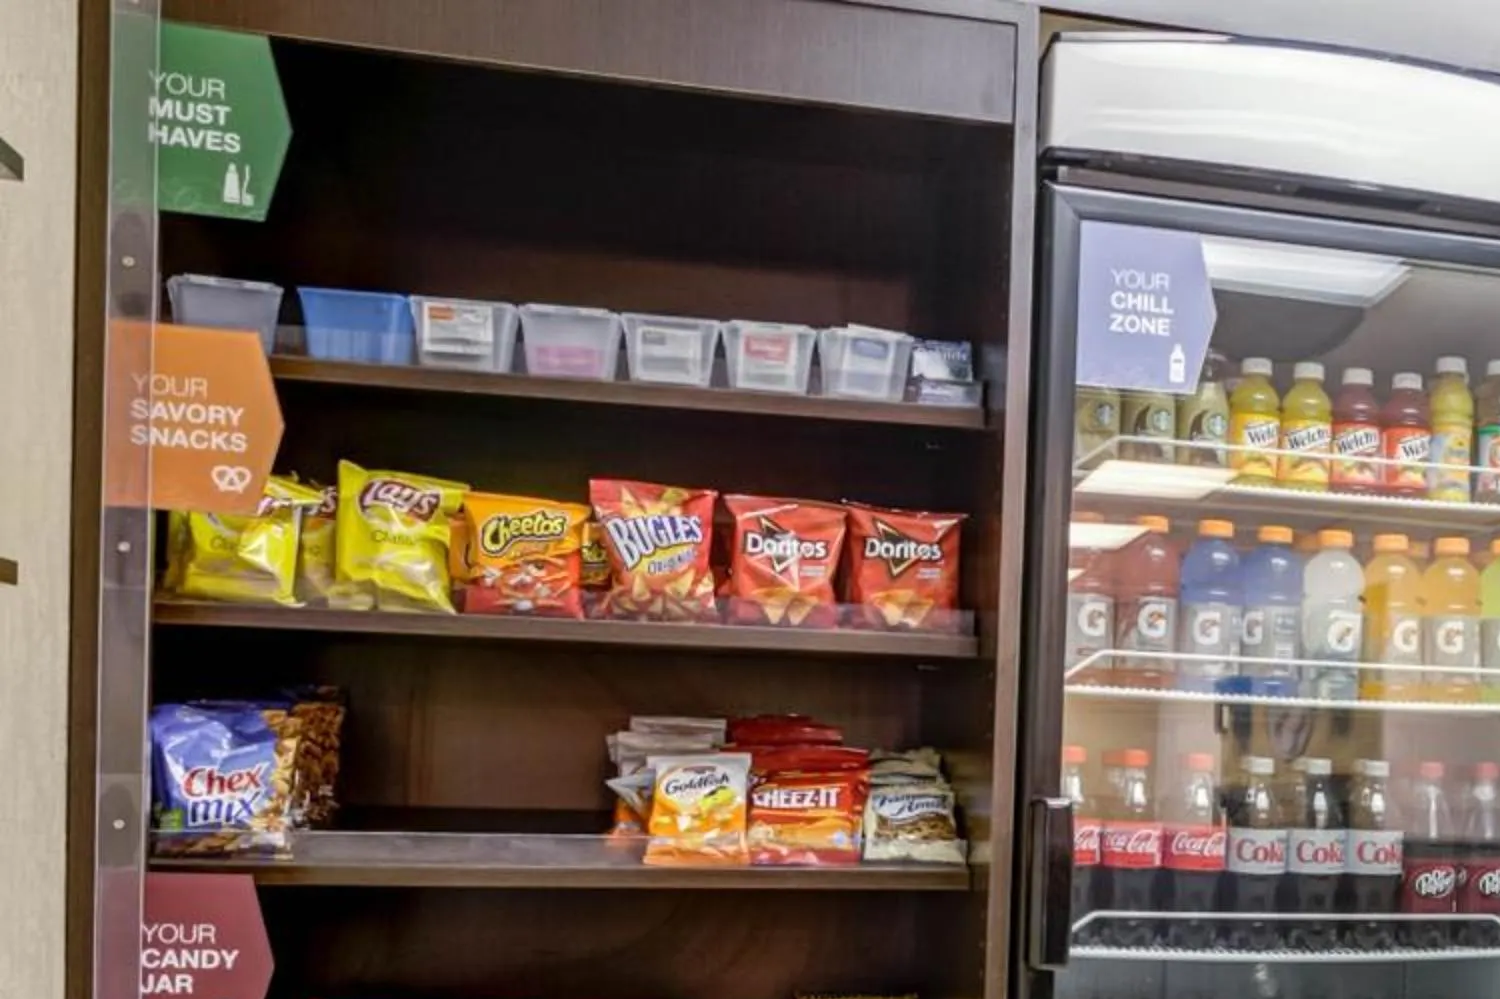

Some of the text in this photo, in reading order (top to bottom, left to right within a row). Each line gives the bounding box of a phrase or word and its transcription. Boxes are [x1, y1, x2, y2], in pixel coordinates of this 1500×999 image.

[148, 70, 225, 100] YOUR
[148, 97, 231, 126] MUST
[148, 125, 241, 153] HAVES
[1110, 269, 1170, 291] YOUR
[1110, 291, 1173, 314] CHILL
[1109, 315, 1170, 336] ZONE
[131, 373, 208, 399] YOUR
[130, 399, 243, 426] SAVORY
[130, 424, 248, 453] SNACKS
[483, 512, 566, 553] Cheetos
[604, 515, 702, 571] BUGLES
[745, 532, 827, 558] Doritos
[865, 535, 942, 561] Doritos
[184, 764, 264, 797] Chex
[665, 773, 729, 795] Goldfish
[141, 923, 216, 945] YOUR
[140, 948, 239, 970] CANDY
[140, 974, 194, 994] JAR
